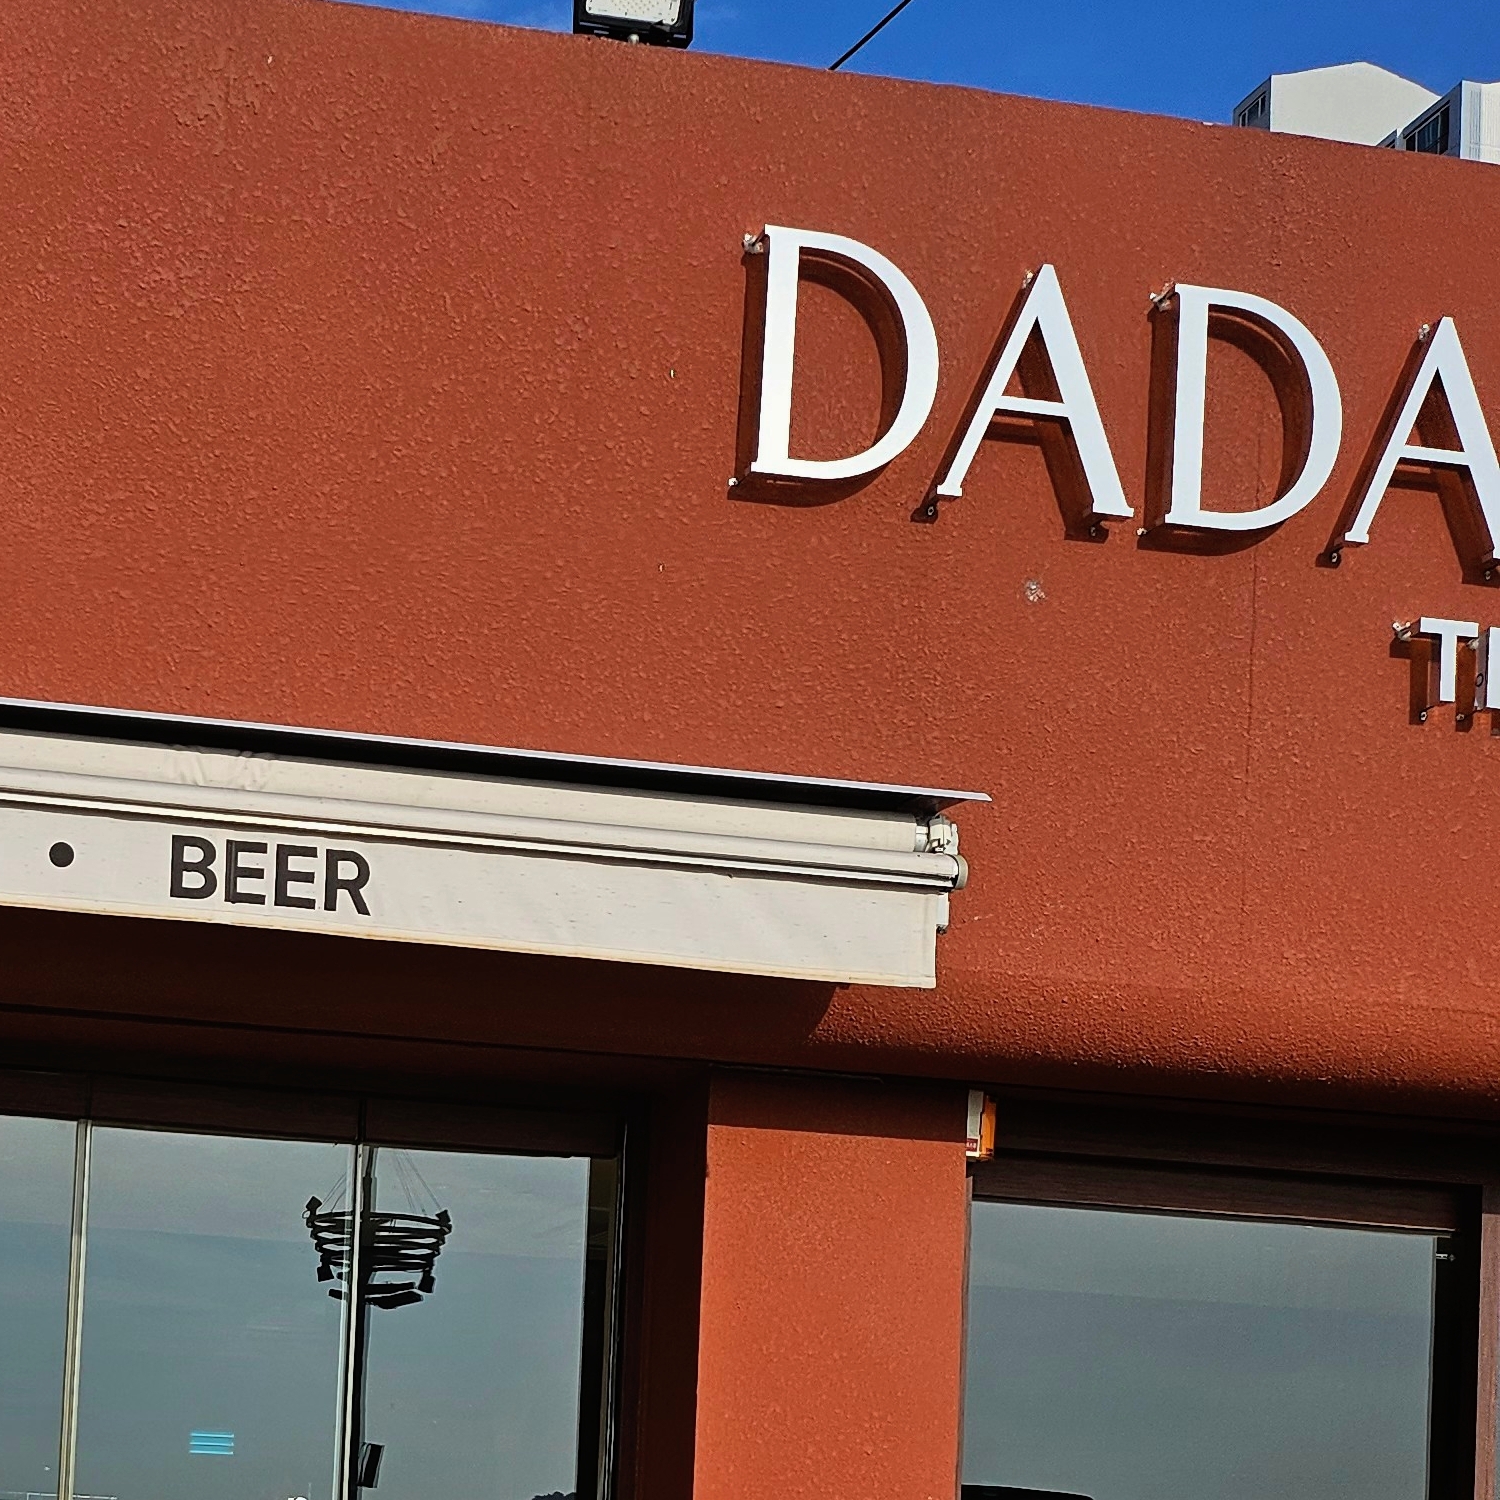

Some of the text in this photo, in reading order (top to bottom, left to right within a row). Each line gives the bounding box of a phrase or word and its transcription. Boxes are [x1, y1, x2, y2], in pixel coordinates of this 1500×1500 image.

[750, 223, 1500, 560] DADA
[1420, 616, 1500, 710] T
[169, 834, 371, 917] BEER
